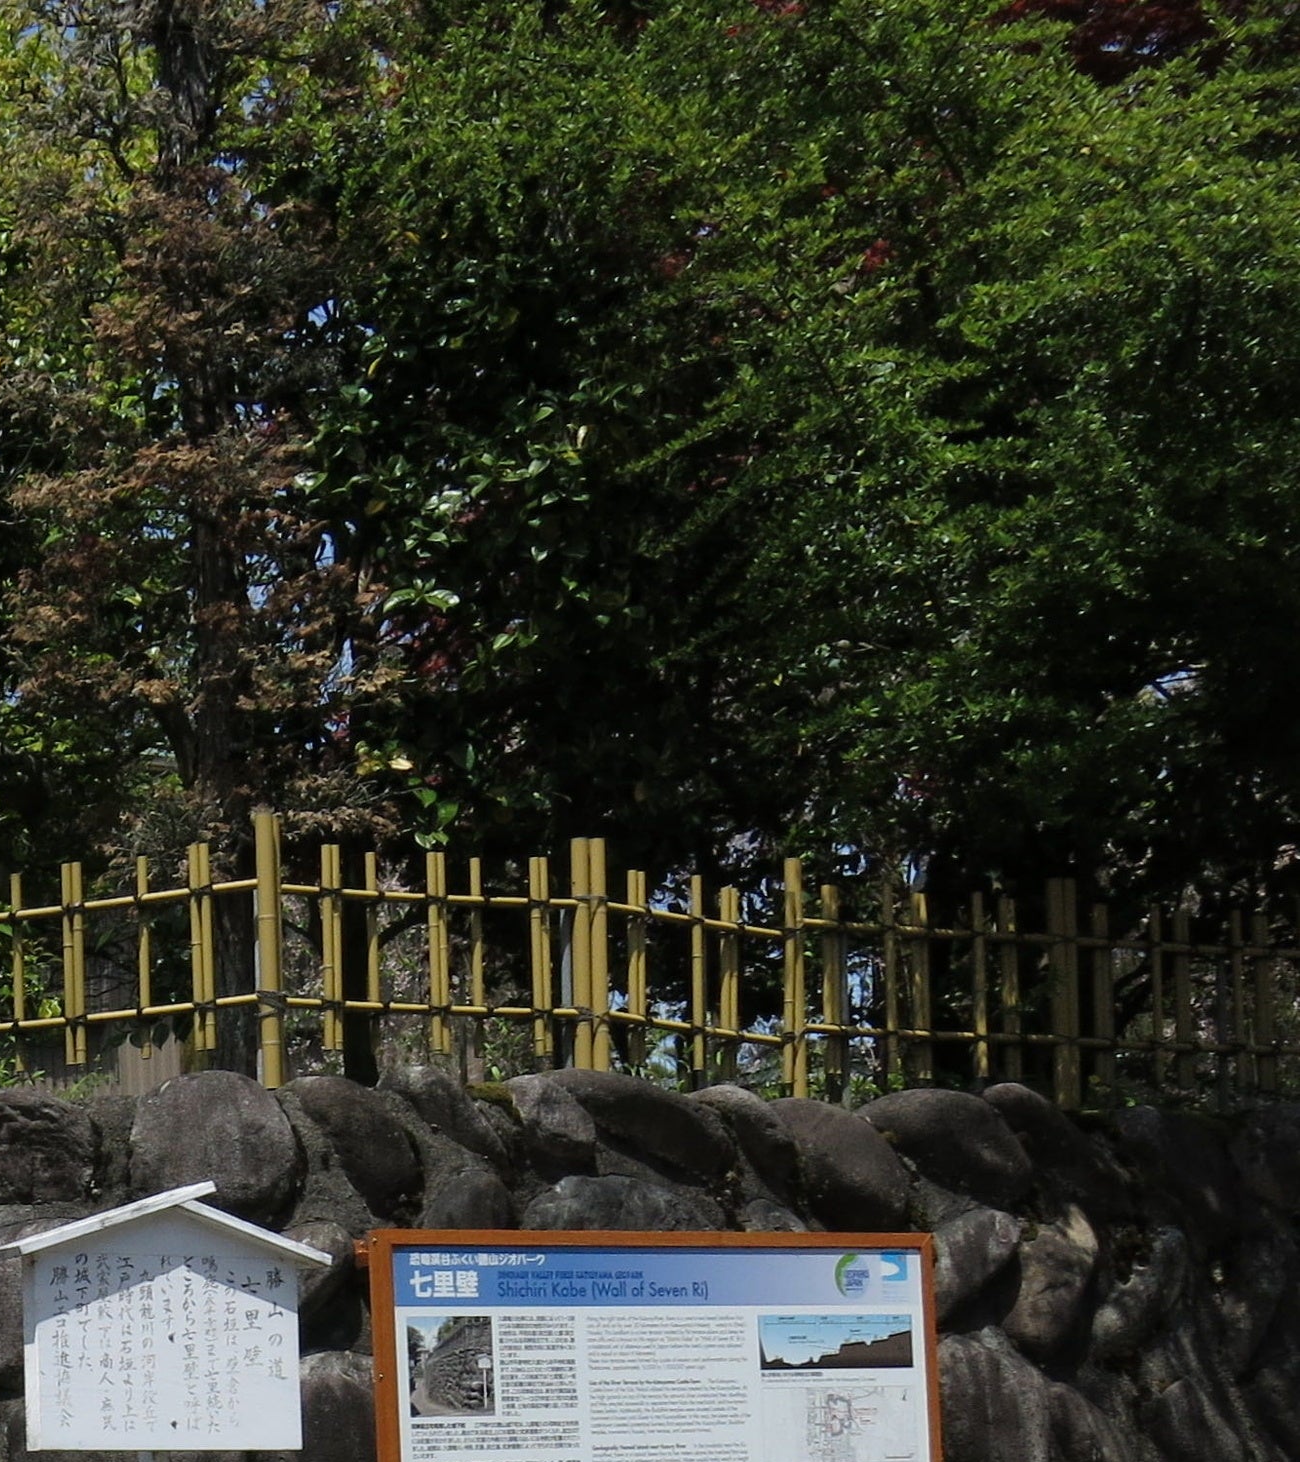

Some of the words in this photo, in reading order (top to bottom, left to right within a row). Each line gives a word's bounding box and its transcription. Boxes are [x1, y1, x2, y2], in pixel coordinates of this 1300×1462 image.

[409, 1269, 480, 1299] 七里壁
[497, 1279, 547, 1298] Shichiri
[551, 1280, 588, 1298] Kabe
[591, 1279, 628, 1301] (Wall
[632, 1279, 644, 1298] of
[648, 1280, 688, 1298] Seven
[692, 1279, 709, 1301] Ri)
[241, 1275, 264, 1368] 七里壁
[264, 1267, 289, 1381] 勝山の道
